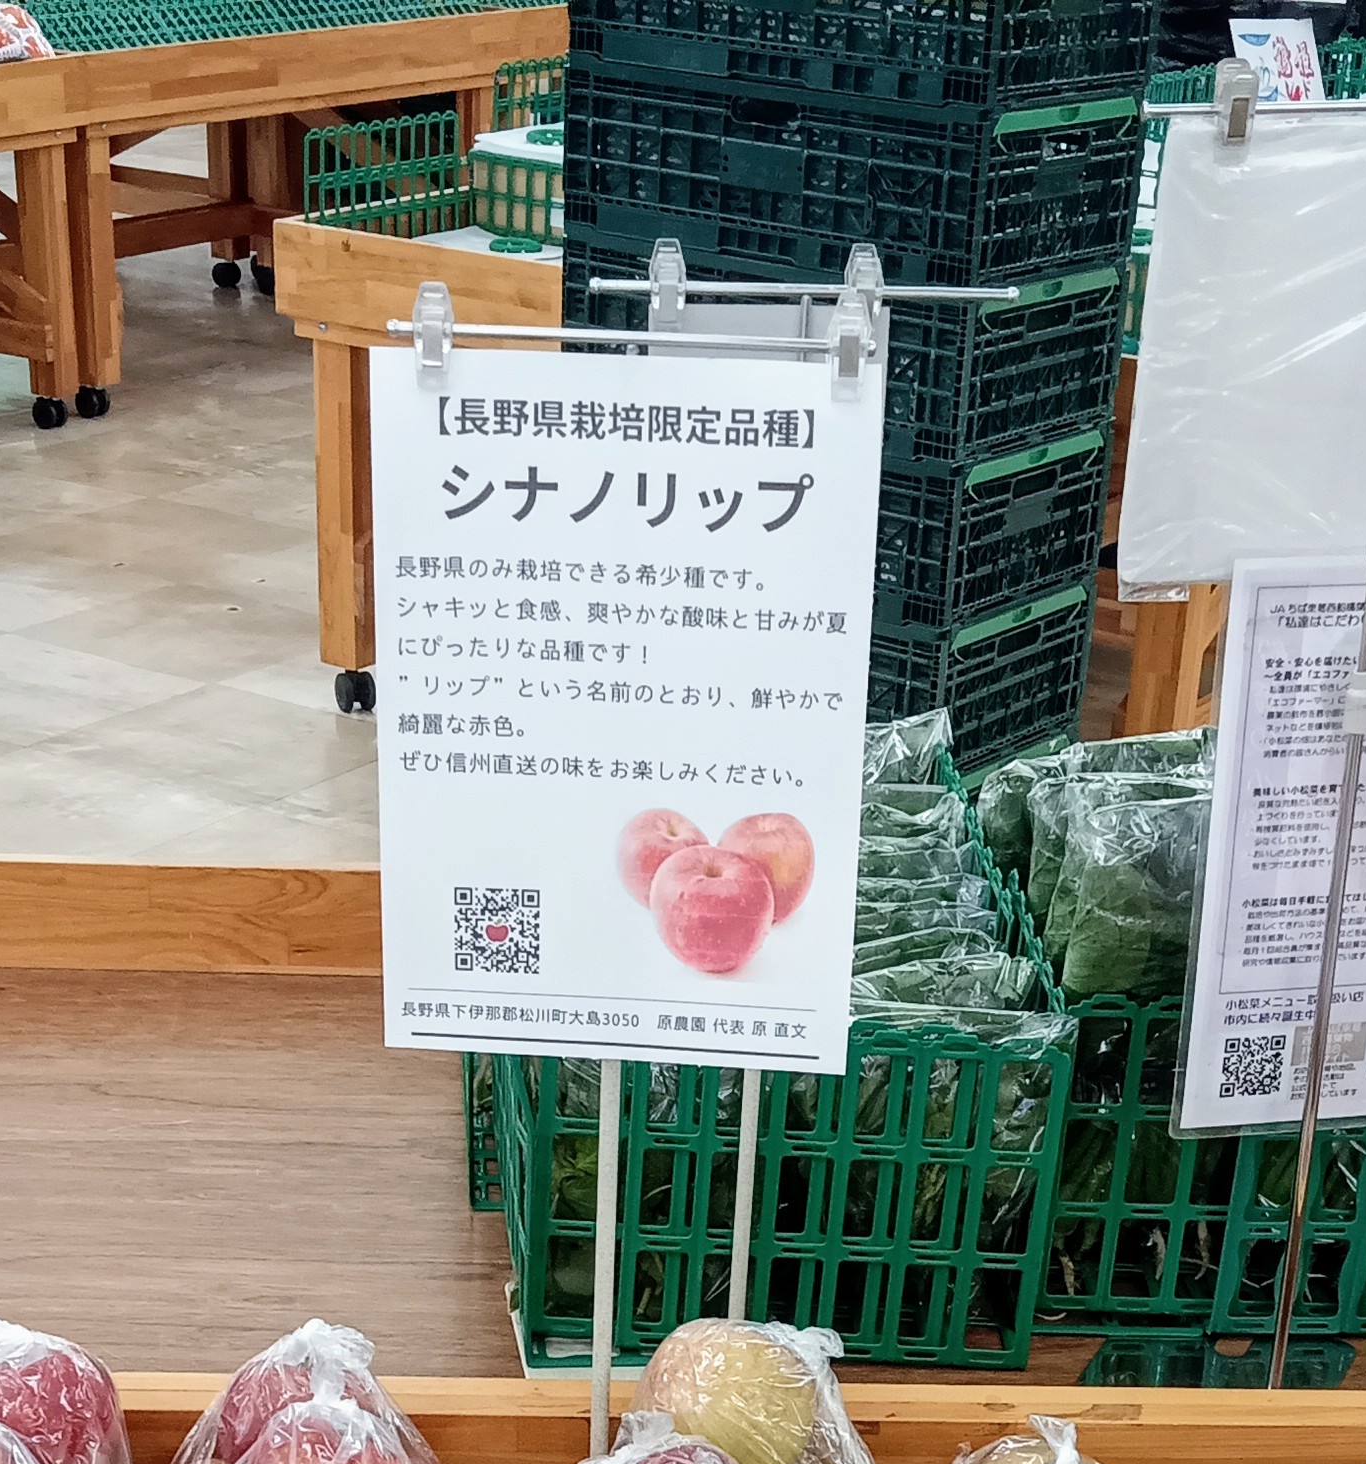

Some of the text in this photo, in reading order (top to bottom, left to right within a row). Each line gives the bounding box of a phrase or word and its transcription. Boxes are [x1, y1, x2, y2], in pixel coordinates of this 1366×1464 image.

[434, 395, 817, 449] 【長野県栽培限定品種】
[441, 464, 815, 533] シナノリップ
[395, 556, 766, 592] 長野県のみ栽培できる希少種です。
[397, 596, 848, 636] シャキッと食感、爽やかな酸味と甘みが夏
[398, 635, 649, 665] にぴったりな品種です！
[398, 713, 527, 739] 綺麗な赤色。
[400, 750, 806, 788] ぜひ信州直送の味をお楽しみください。
[401, 1000, 806, 1040] 長野県下伊那郡松川町大島3050 原農園 代表 原 直文
[1225, 991, 1364, 1011] 小松菜メニュー取扱い店
